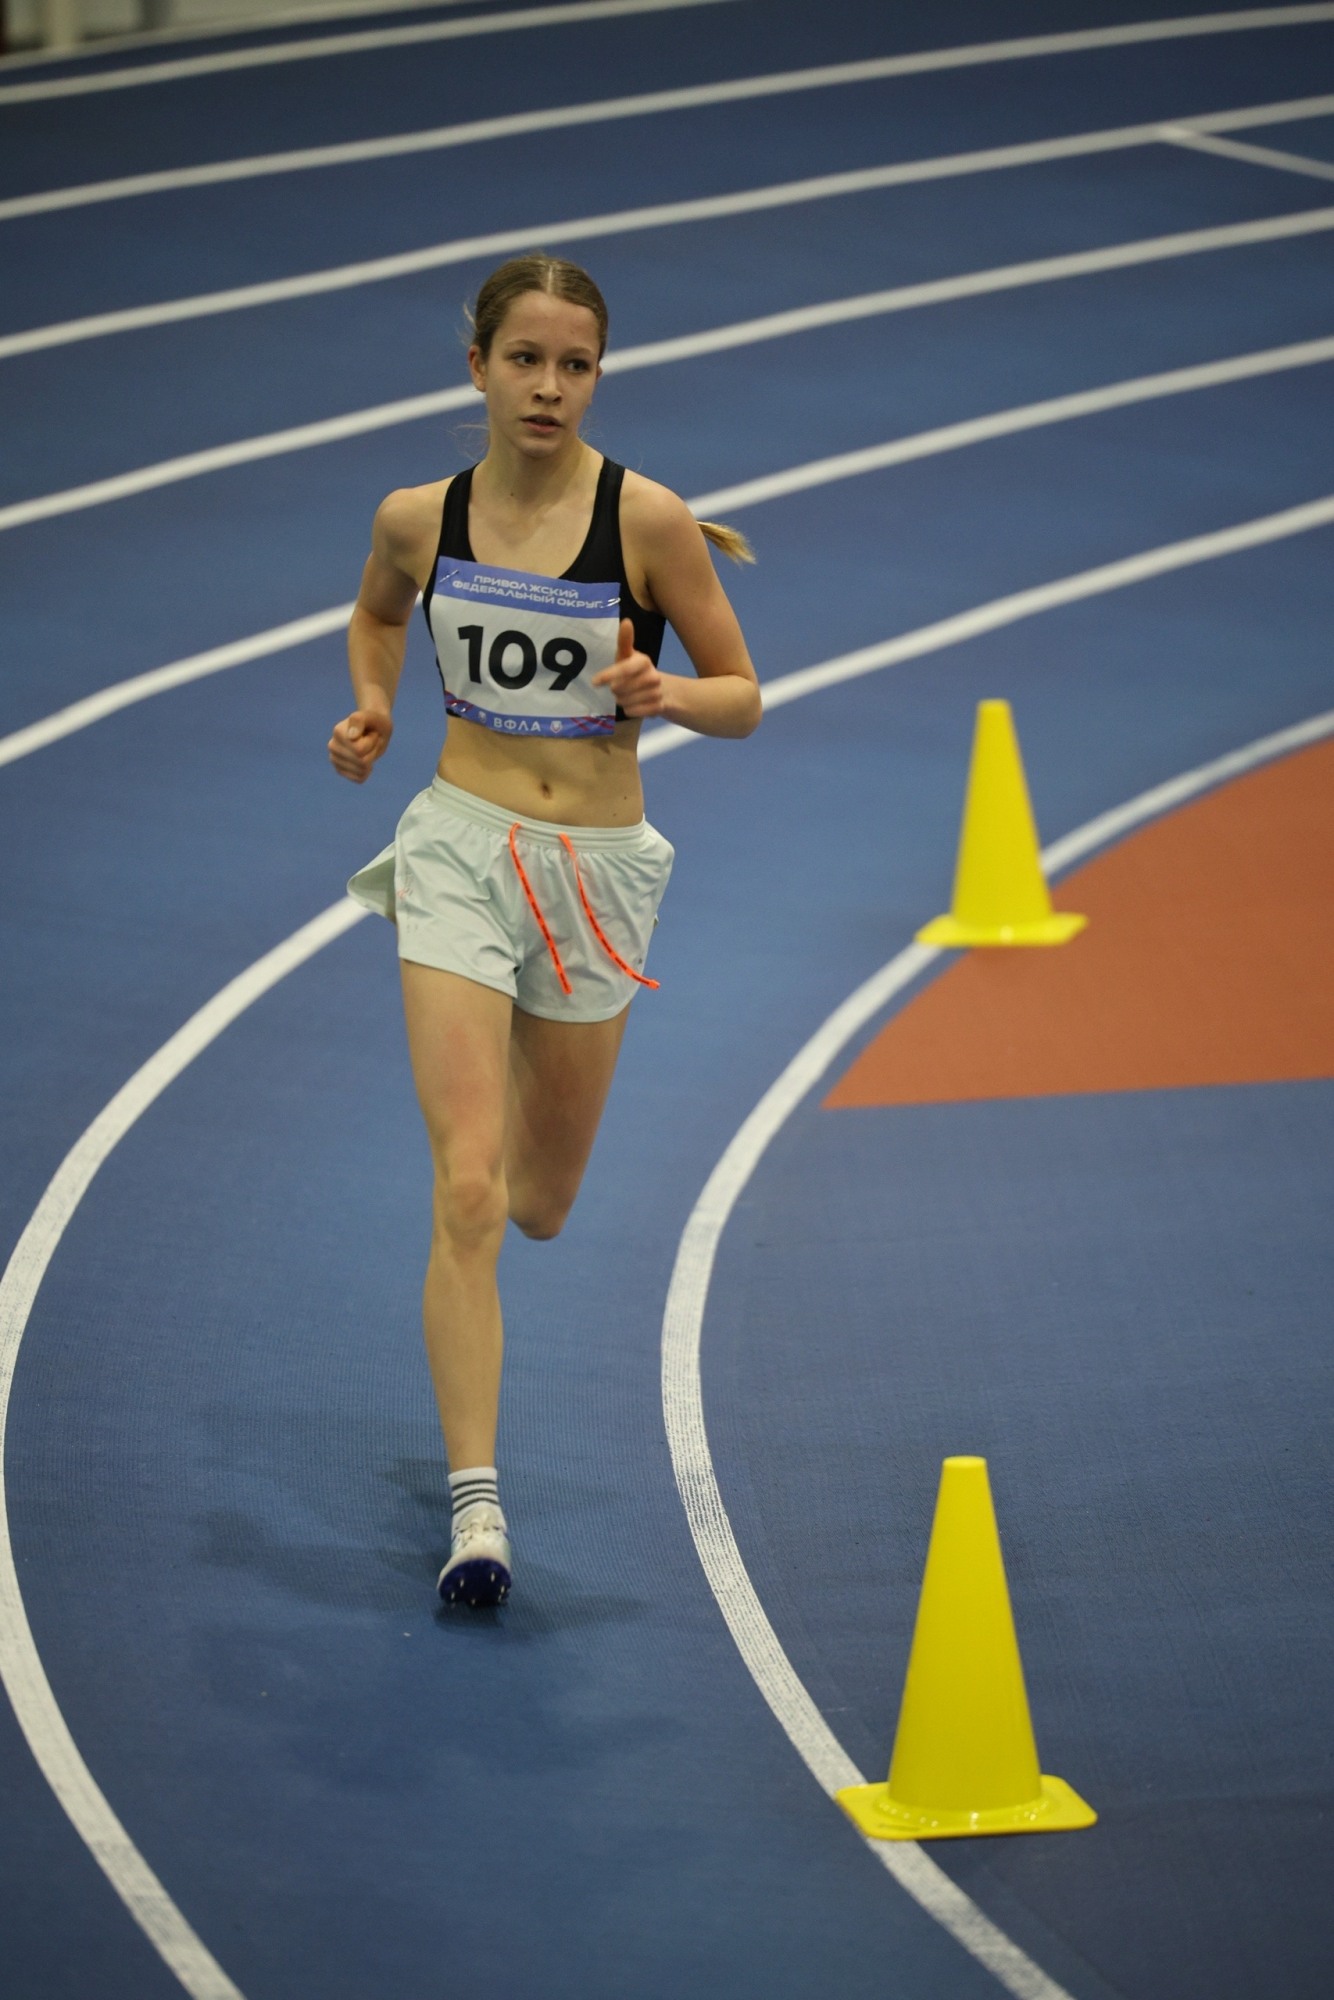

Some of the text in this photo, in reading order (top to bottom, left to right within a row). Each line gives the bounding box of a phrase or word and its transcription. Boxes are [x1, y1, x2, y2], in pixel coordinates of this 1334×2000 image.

[452, 580, 602, 609] ФЕДЕРАЛЬНЫЙ ОКРУГ
[474, 575, 578, 599] ПРИВОЛЖСКИЙ
[458, 625, 587, 691] 109
[494, 718, 541, 732] ВФЛА
